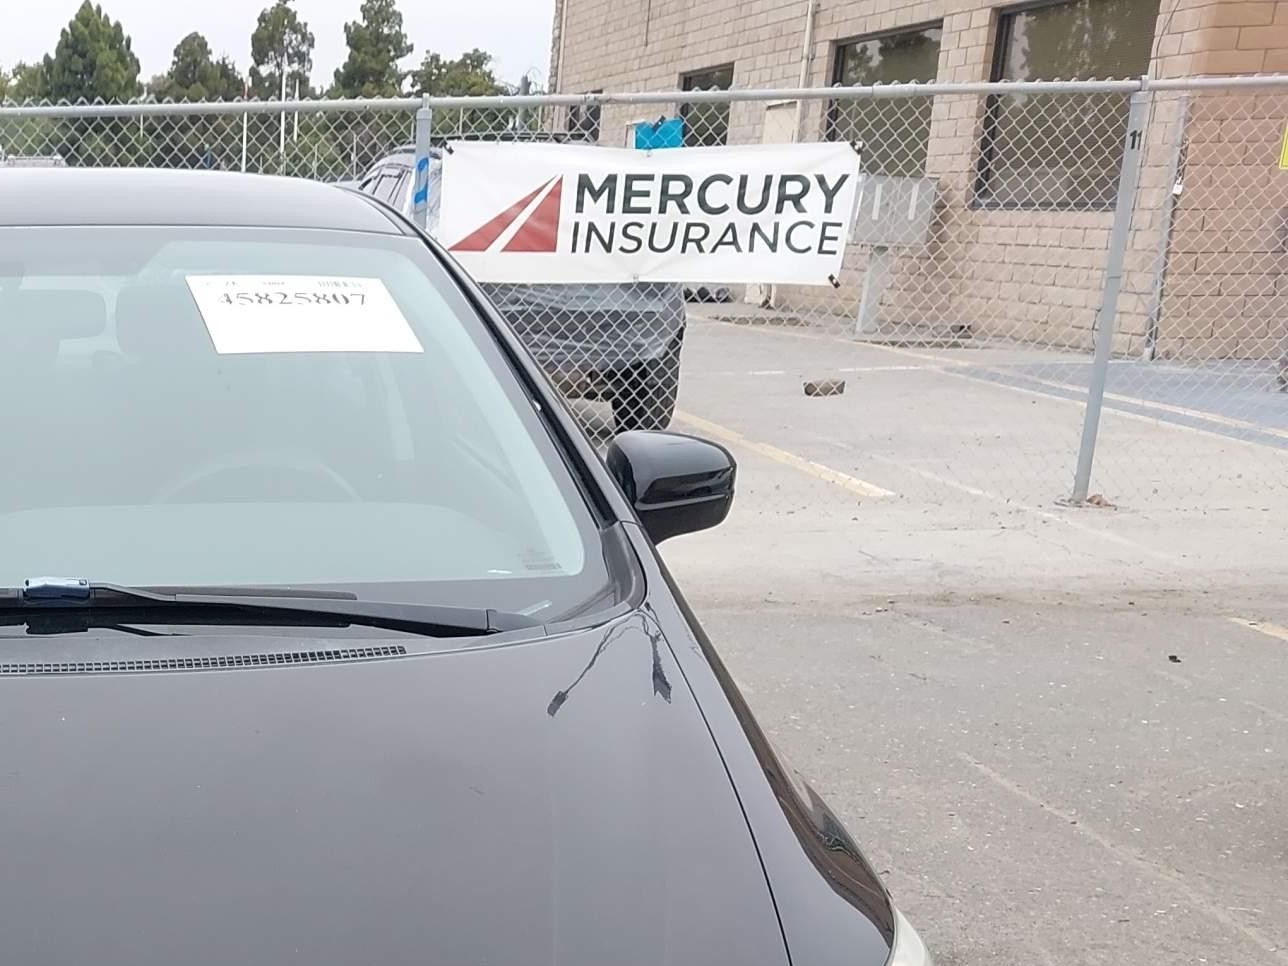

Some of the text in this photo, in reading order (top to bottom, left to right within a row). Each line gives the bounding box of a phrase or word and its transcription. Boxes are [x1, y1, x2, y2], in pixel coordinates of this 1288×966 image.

[575, 174, 850, 215] MERCURY
[571, 221, 843, 255] INSURANCE
[220, 292, 366, 305] 45825807
